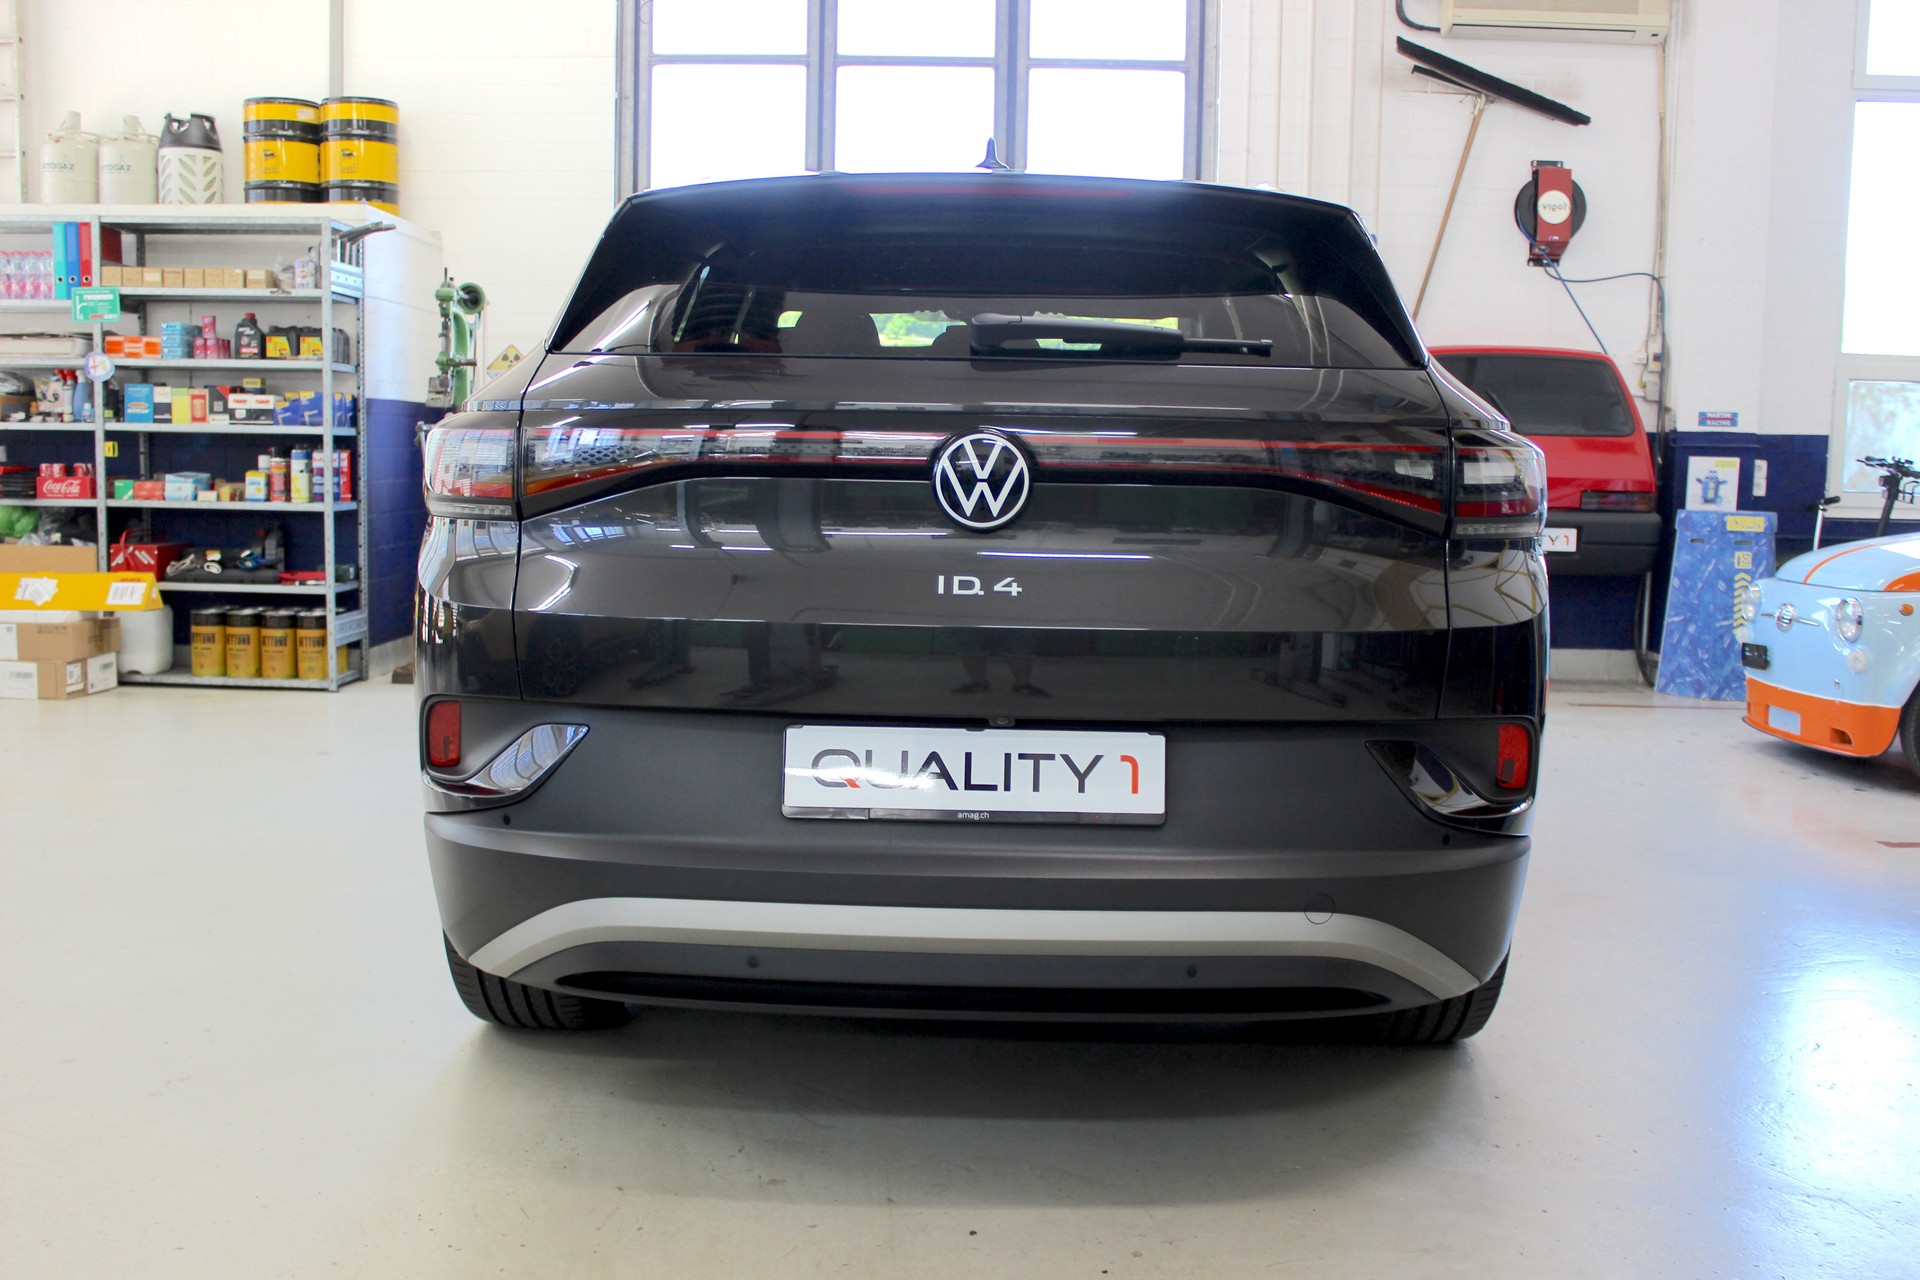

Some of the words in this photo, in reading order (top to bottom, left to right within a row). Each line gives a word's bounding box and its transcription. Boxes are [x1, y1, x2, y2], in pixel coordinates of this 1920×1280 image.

[811, 748, 1104, 794] QUALITY
[1119, 754, 1140, 795] 1
[957, 811, 990, 820] amag.ch
